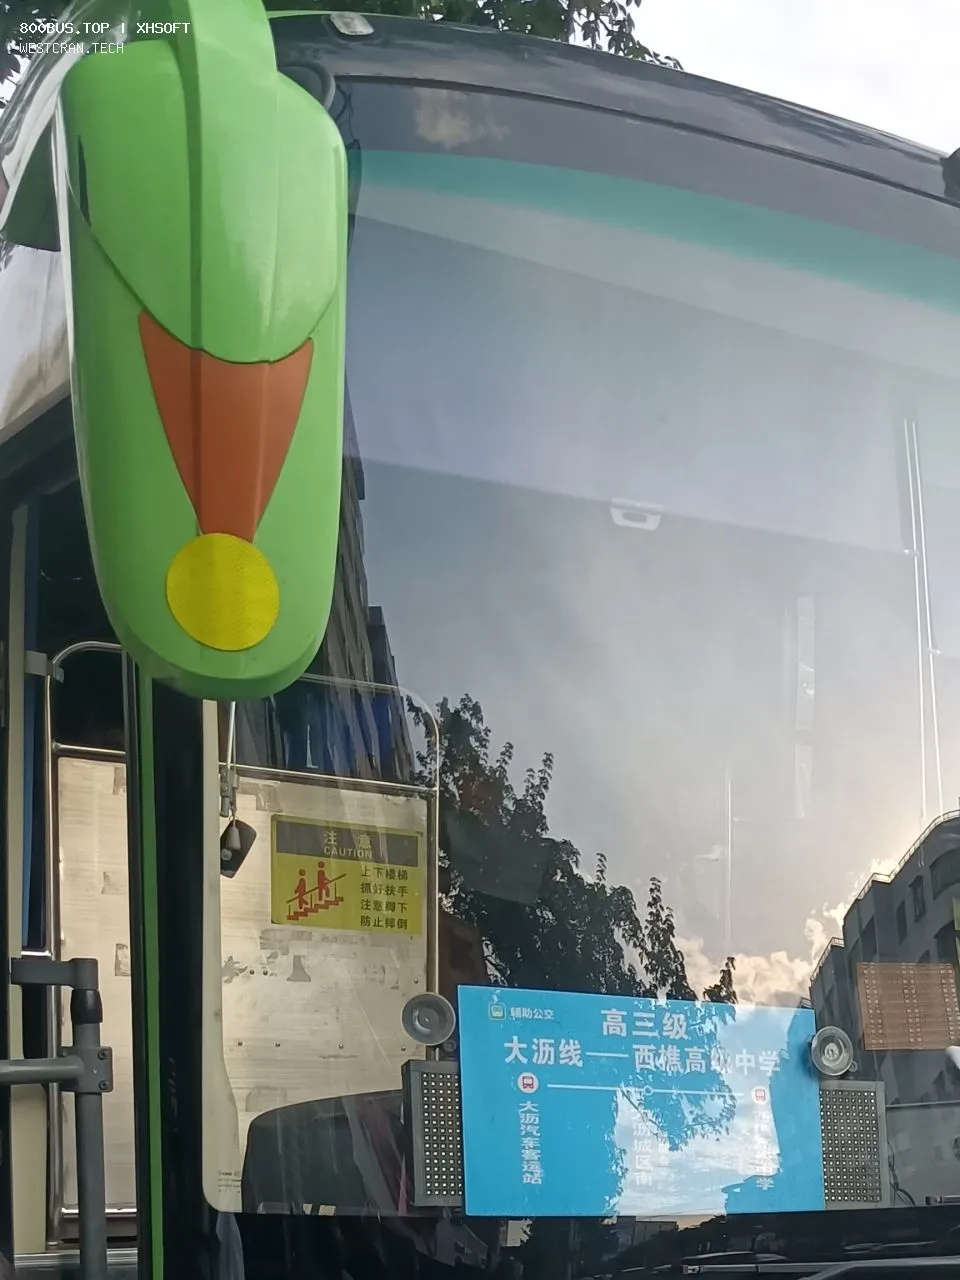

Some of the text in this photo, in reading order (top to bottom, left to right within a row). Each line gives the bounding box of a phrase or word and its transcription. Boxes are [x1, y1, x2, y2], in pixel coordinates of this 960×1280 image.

[324, 847, 372, 859] CAUTION
[360, 882, 408, 897] 抓好扶手
[361, 915, 407, 929] 防止摔倒
[510, 1007, 554, 1020] 辅助公交
[602, 1009, 688, 1040] 高三级
[519, 1101, 543, 1185] 大沥汽车客运站
